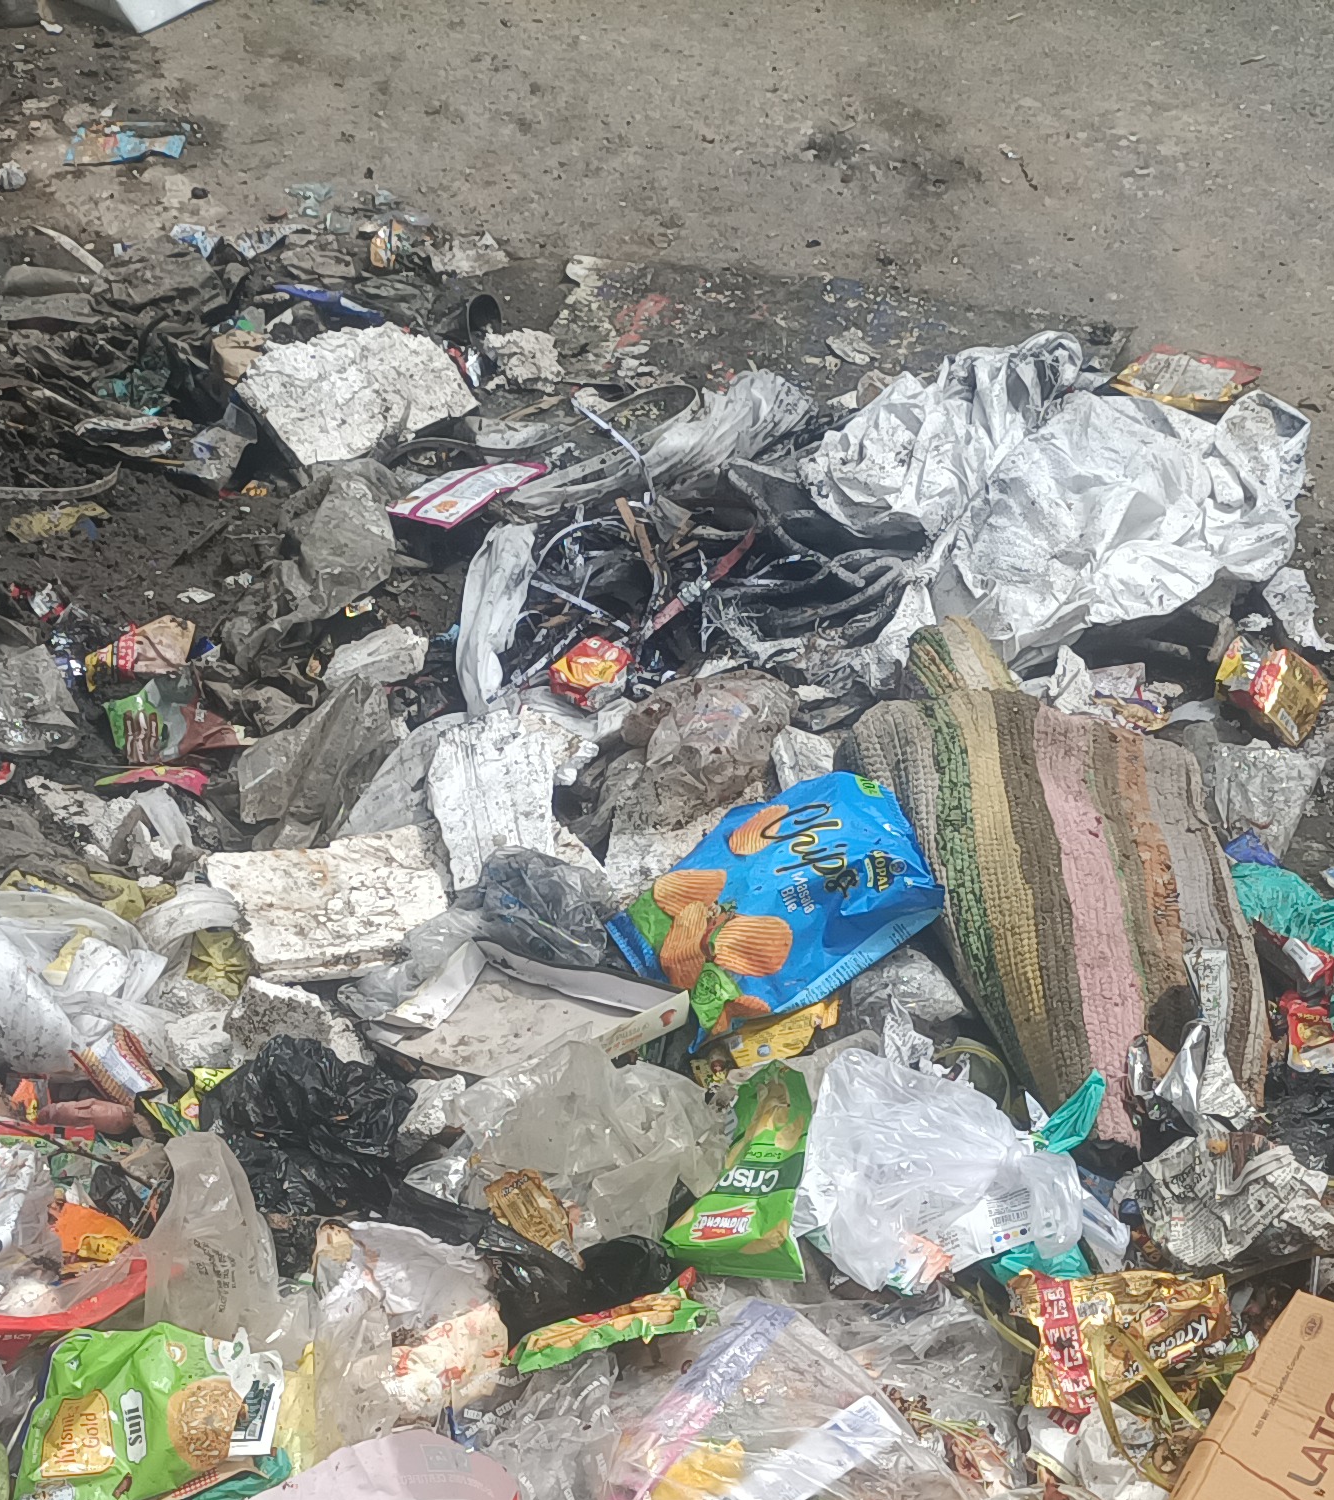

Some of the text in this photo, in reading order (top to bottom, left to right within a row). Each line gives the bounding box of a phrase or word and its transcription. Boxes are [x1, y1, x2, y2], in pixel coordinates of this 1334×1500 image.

[761, 803, 858, 899] Chips
[790, 871, 816, 915] Masala
[79, 1411, 102, 1450] Gold
[124, 1405, 144, 1448] Suji
